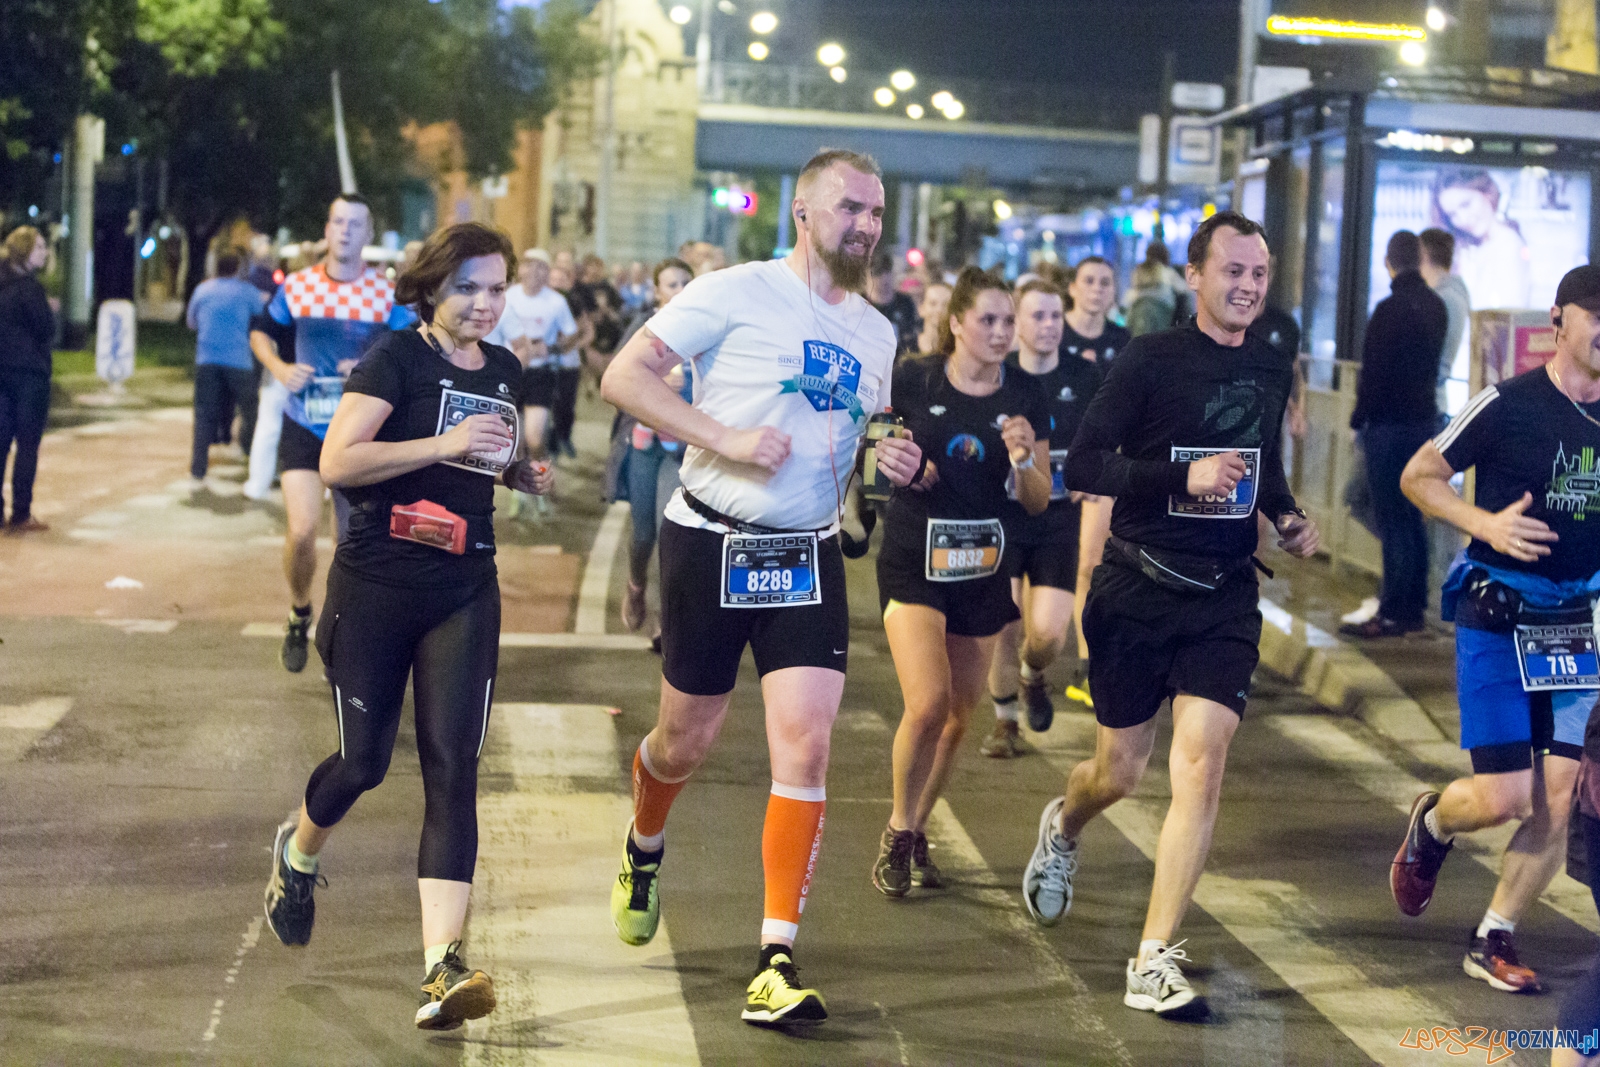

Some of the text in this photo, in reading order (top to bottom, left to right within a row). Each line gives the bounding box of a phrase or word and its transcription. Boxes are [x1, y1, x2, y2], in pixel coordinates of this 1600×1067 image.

[778, 357, 803, 367] SINCE
[808, 343, 856, 376] REBEL
[799, 376, 857, 407] RUNNERS
[947, 548, 985, 569] 6832
[747, 569, 793, 592] 8289
[1546, 655, 1578, 675] 715
